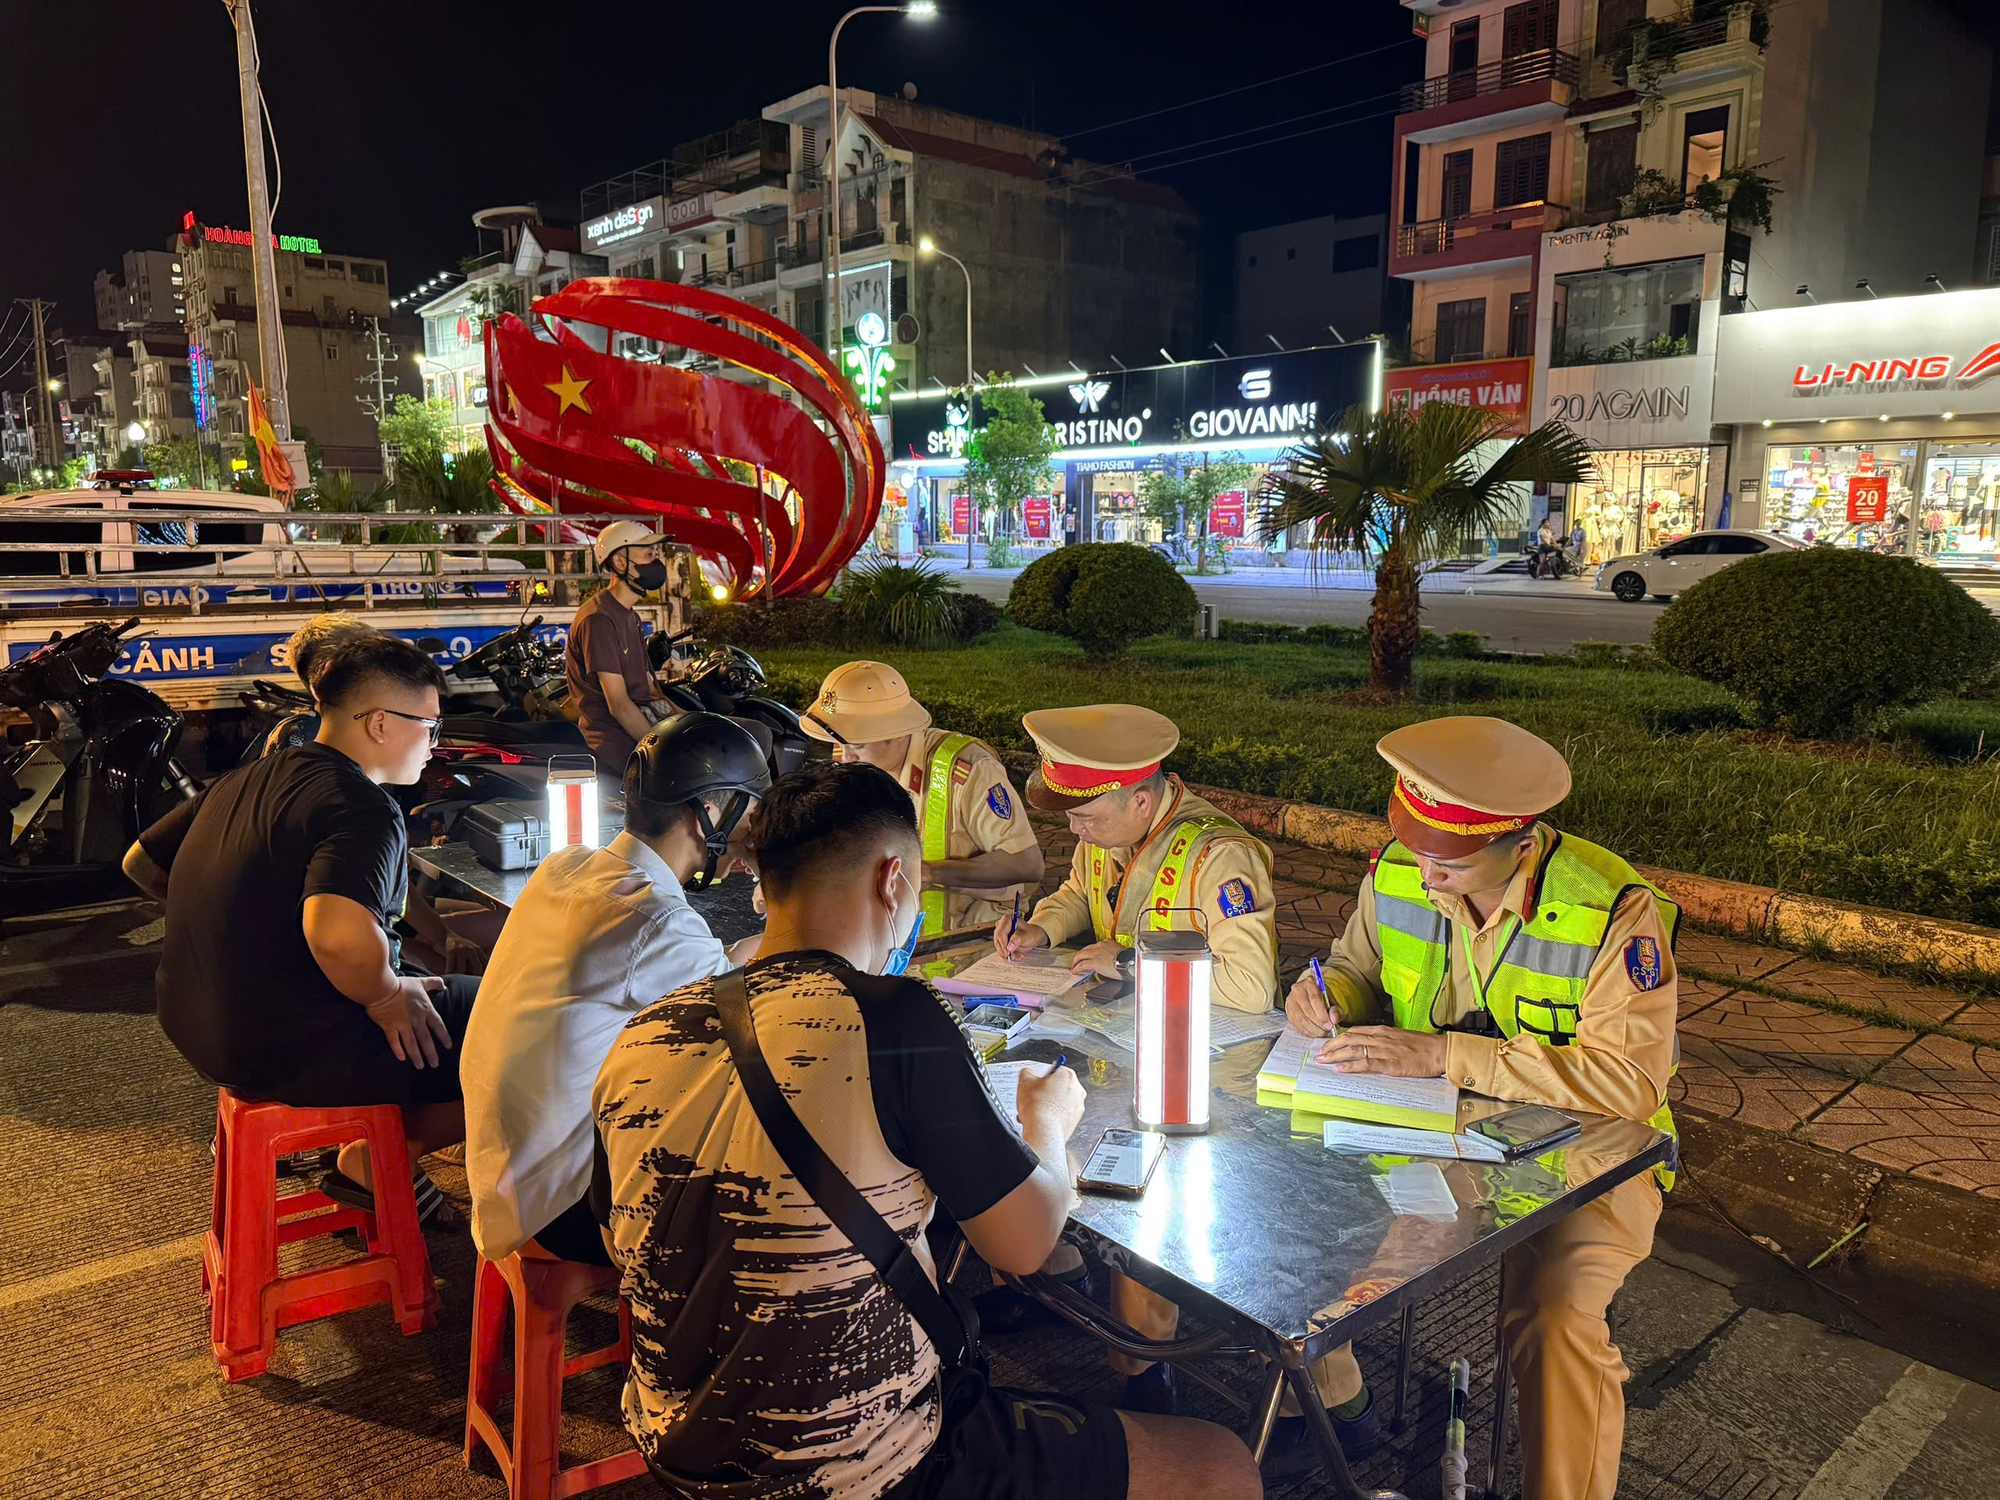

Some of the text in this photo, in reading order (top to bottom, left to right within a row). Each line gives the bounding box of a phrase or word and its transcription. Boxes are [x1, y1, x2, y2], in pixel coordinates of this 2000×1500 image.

[204, 225, 253, 246] HOÀNG
[280, 235, 322, 254] HOTEL
[587, 216, 613, 239] xanh
[1548, 230, 1593, 248] TWENTY
[1792, 355, 1953, 387] LI-NING
[1477, 381, 1522, 406] VĂN
[1550, 385, 1690, 422] 20 AGAIN
[1100, 459, 1135, 471] FASHION
[1855, 490, 1879, 506] 20
[108, 640, 215, 675] CẢNH
[30, 760, 62, 768] HONDA
